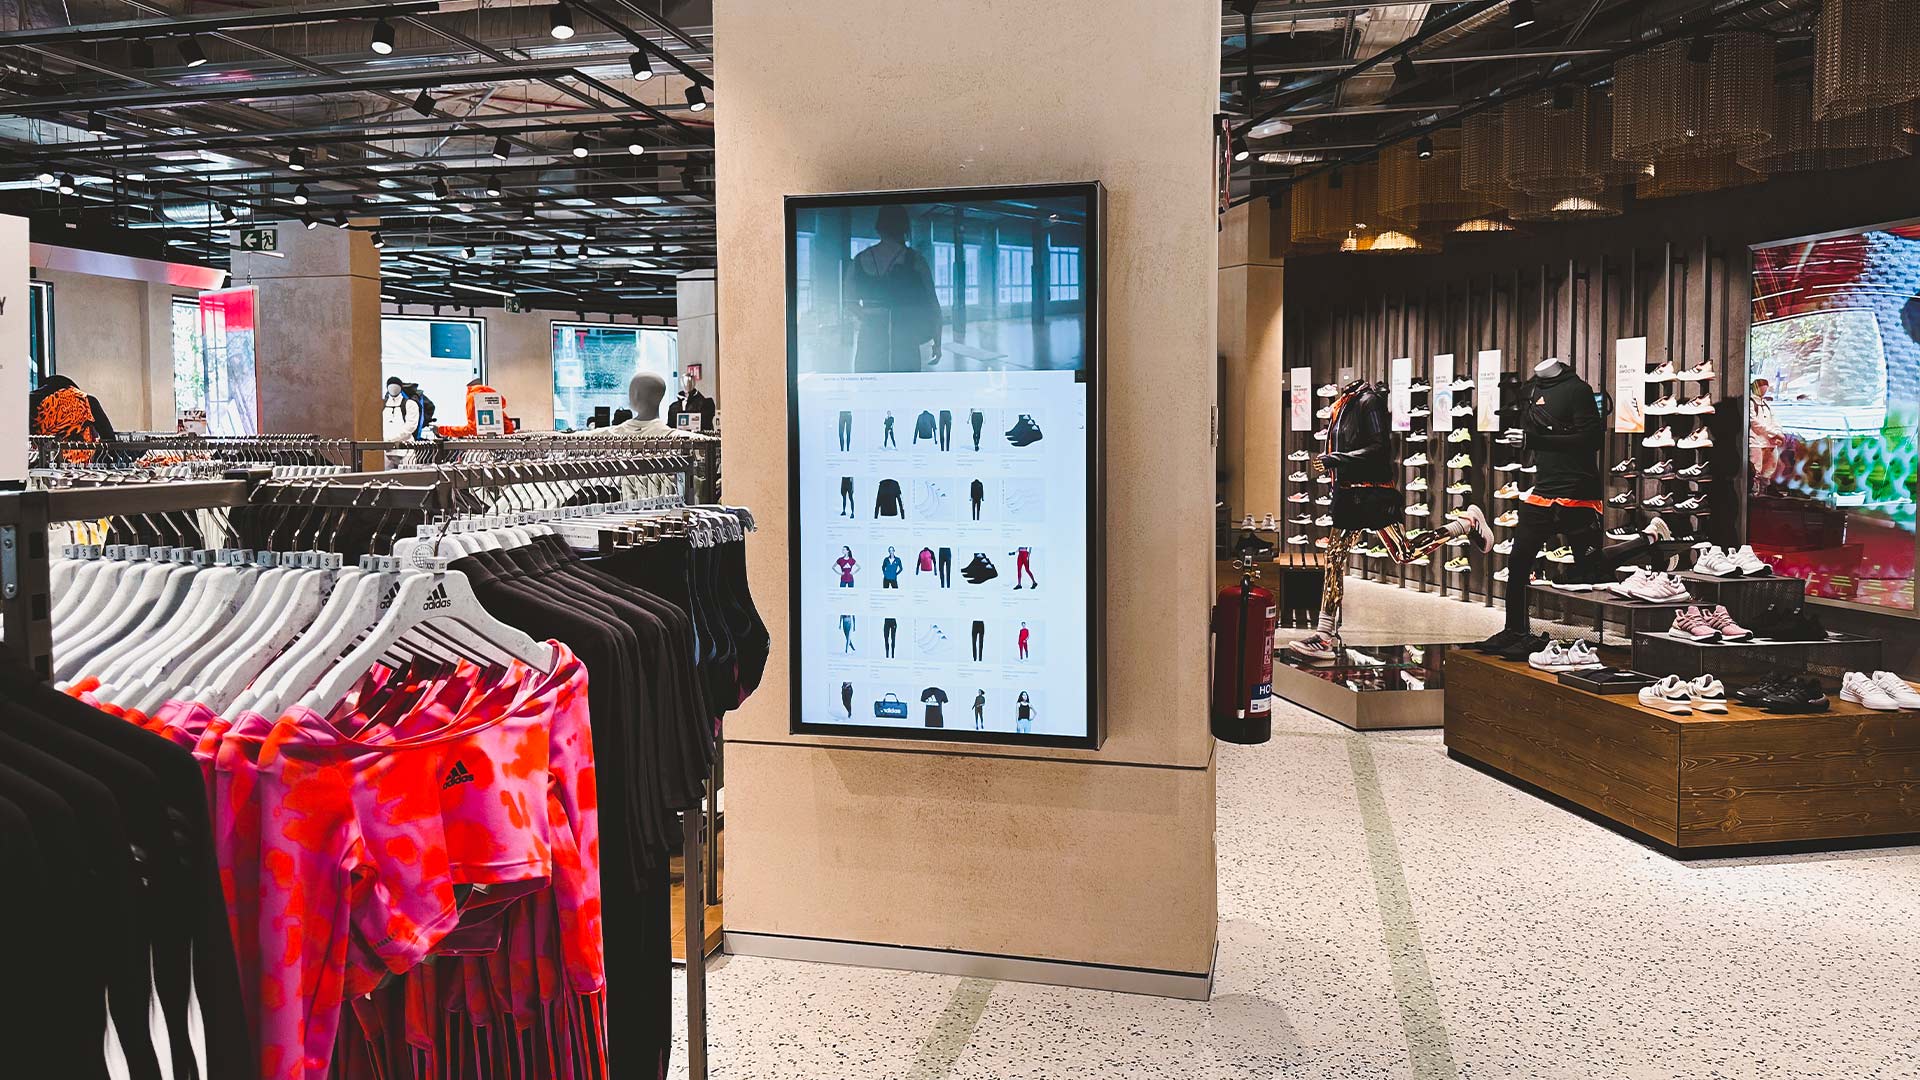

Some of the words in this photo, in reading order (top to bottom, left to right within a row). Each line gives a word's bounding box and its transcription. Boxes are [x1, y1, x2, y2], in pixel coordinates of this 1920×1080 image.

[423, 599, 452, 611] adidas
[1259, 684, 1273, 695] HO
[443, 774, 474, 790] adidas
